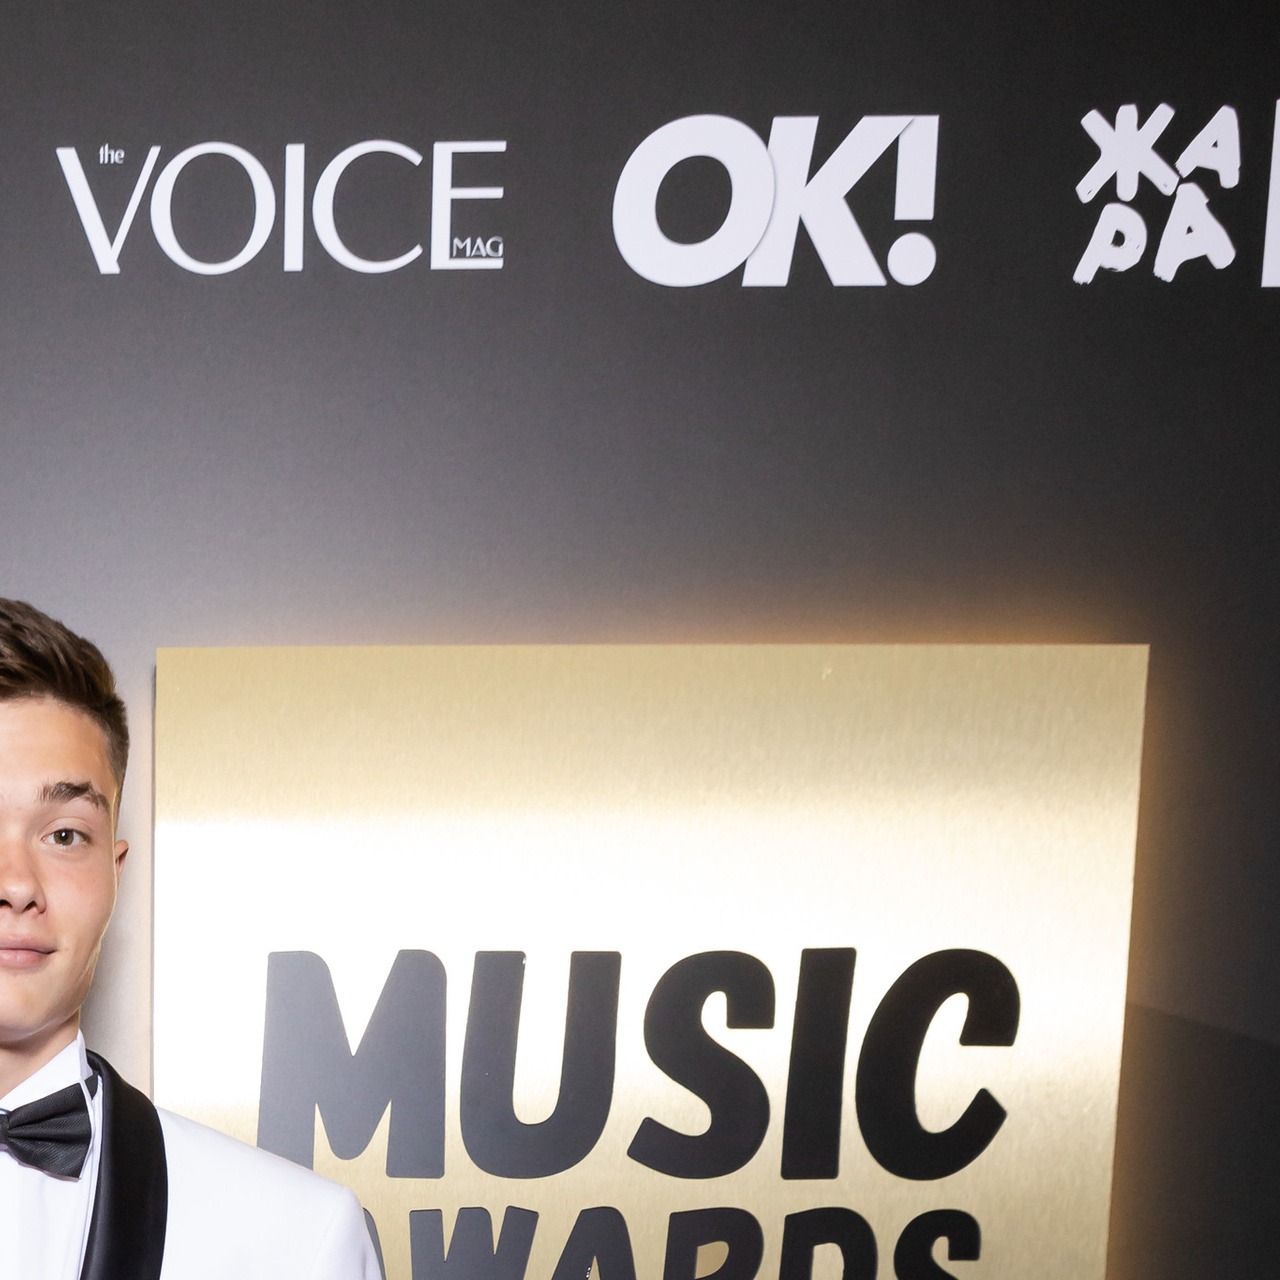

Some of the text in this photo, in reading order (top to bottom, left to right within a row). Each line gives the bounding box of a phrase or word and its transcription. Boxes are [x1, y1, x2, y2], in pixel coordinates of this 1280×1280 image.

[56, 140, 507, 274] VOICE
[99, 143, 125, 164] the
[613, 115, 939, 287] OK!
[453, 236, 504, 259] MAG
[257, 947, 1021, 1181] MUSIC
